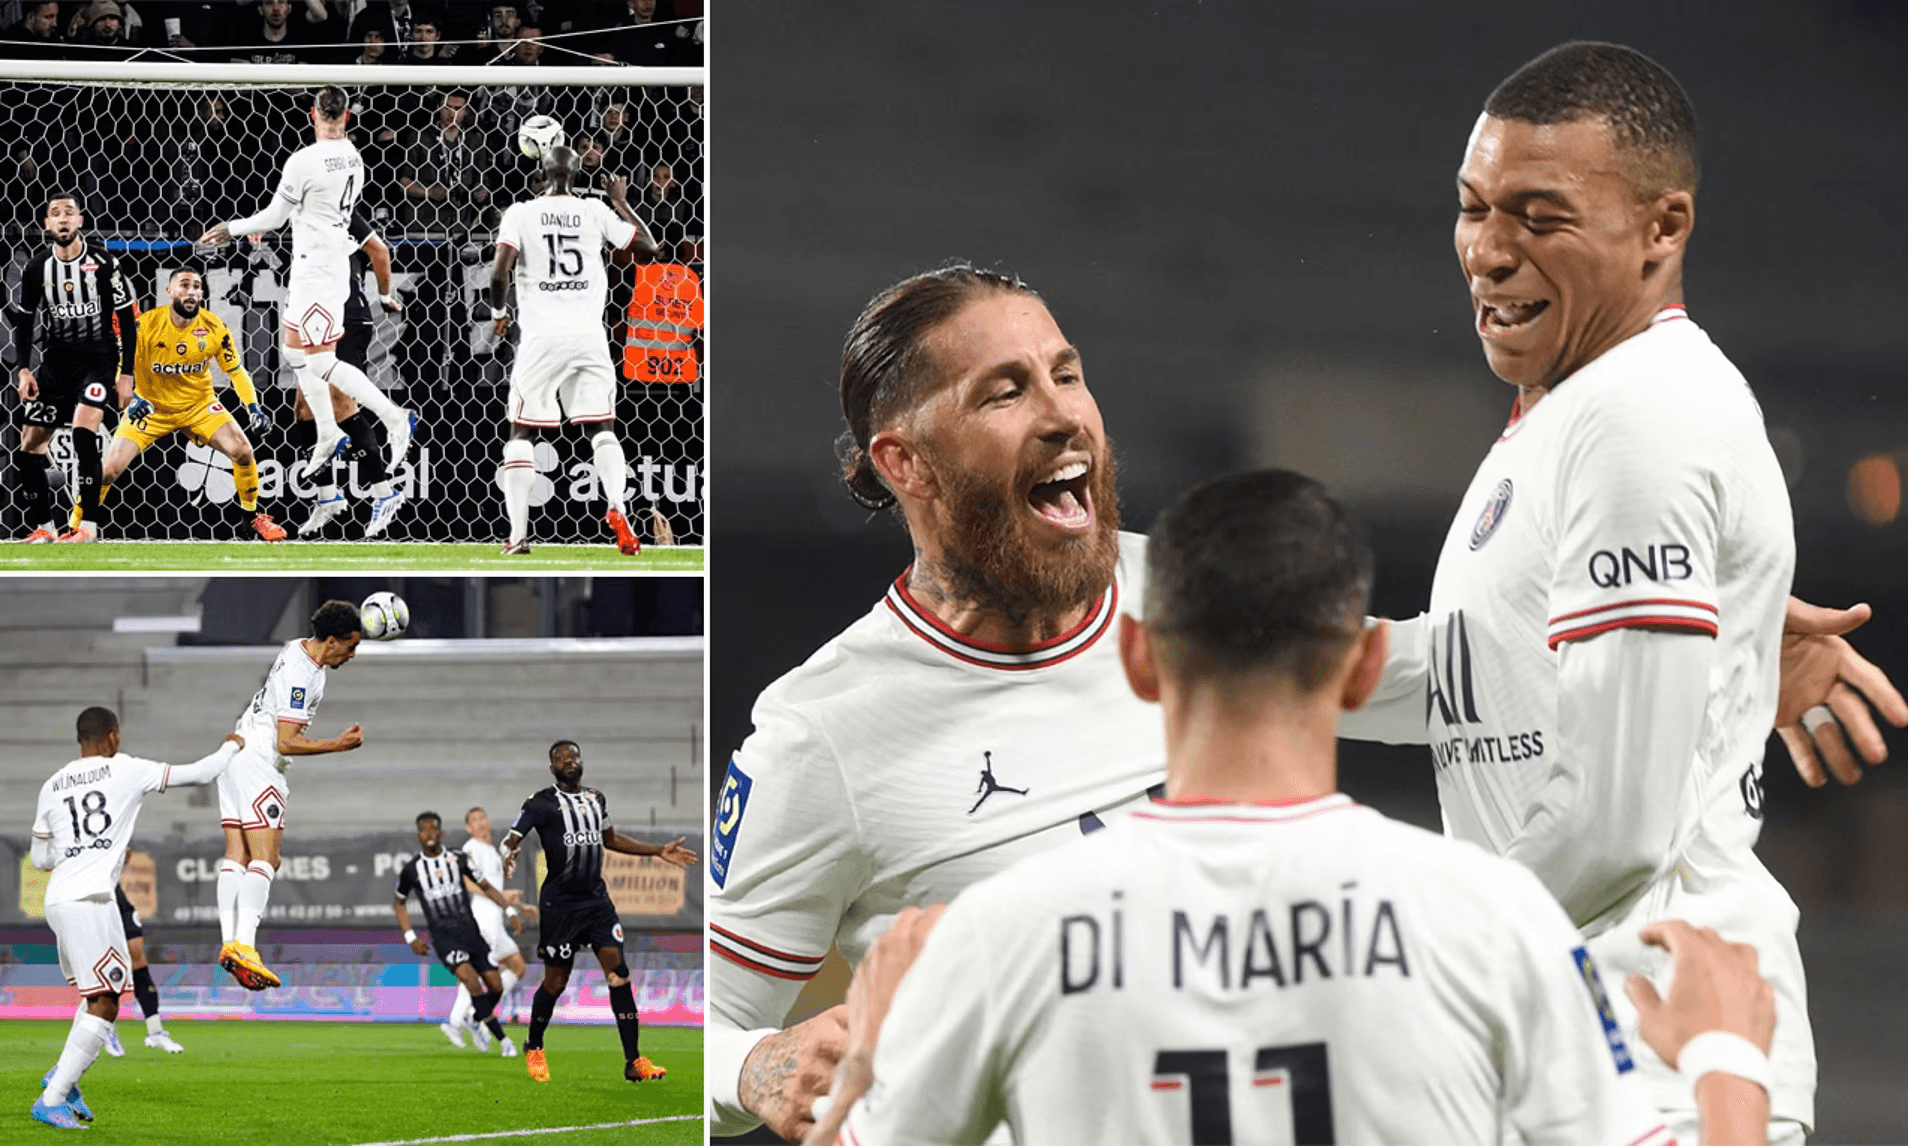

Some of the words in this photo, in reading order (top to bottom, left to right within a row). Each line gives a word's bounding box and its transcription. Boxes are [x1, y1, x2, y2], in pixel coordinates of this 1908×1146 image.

[340, 174, 354, 212] 4
[542, 233, 584, 278] 15
[152, 359, 208, 374] actual
[29, 401, 58, 423] 23
[258, 448, 430, 499] actual
[569, 455, 704, 502] atu
[1589, 544, 1693, 588] QNB
[63, 790, 112, 843] 18
[559, 942, 572, 959] 8
[1172, 881, 1410, 990] MARÍA
[1151, 1041, 1336, 1146] 11
